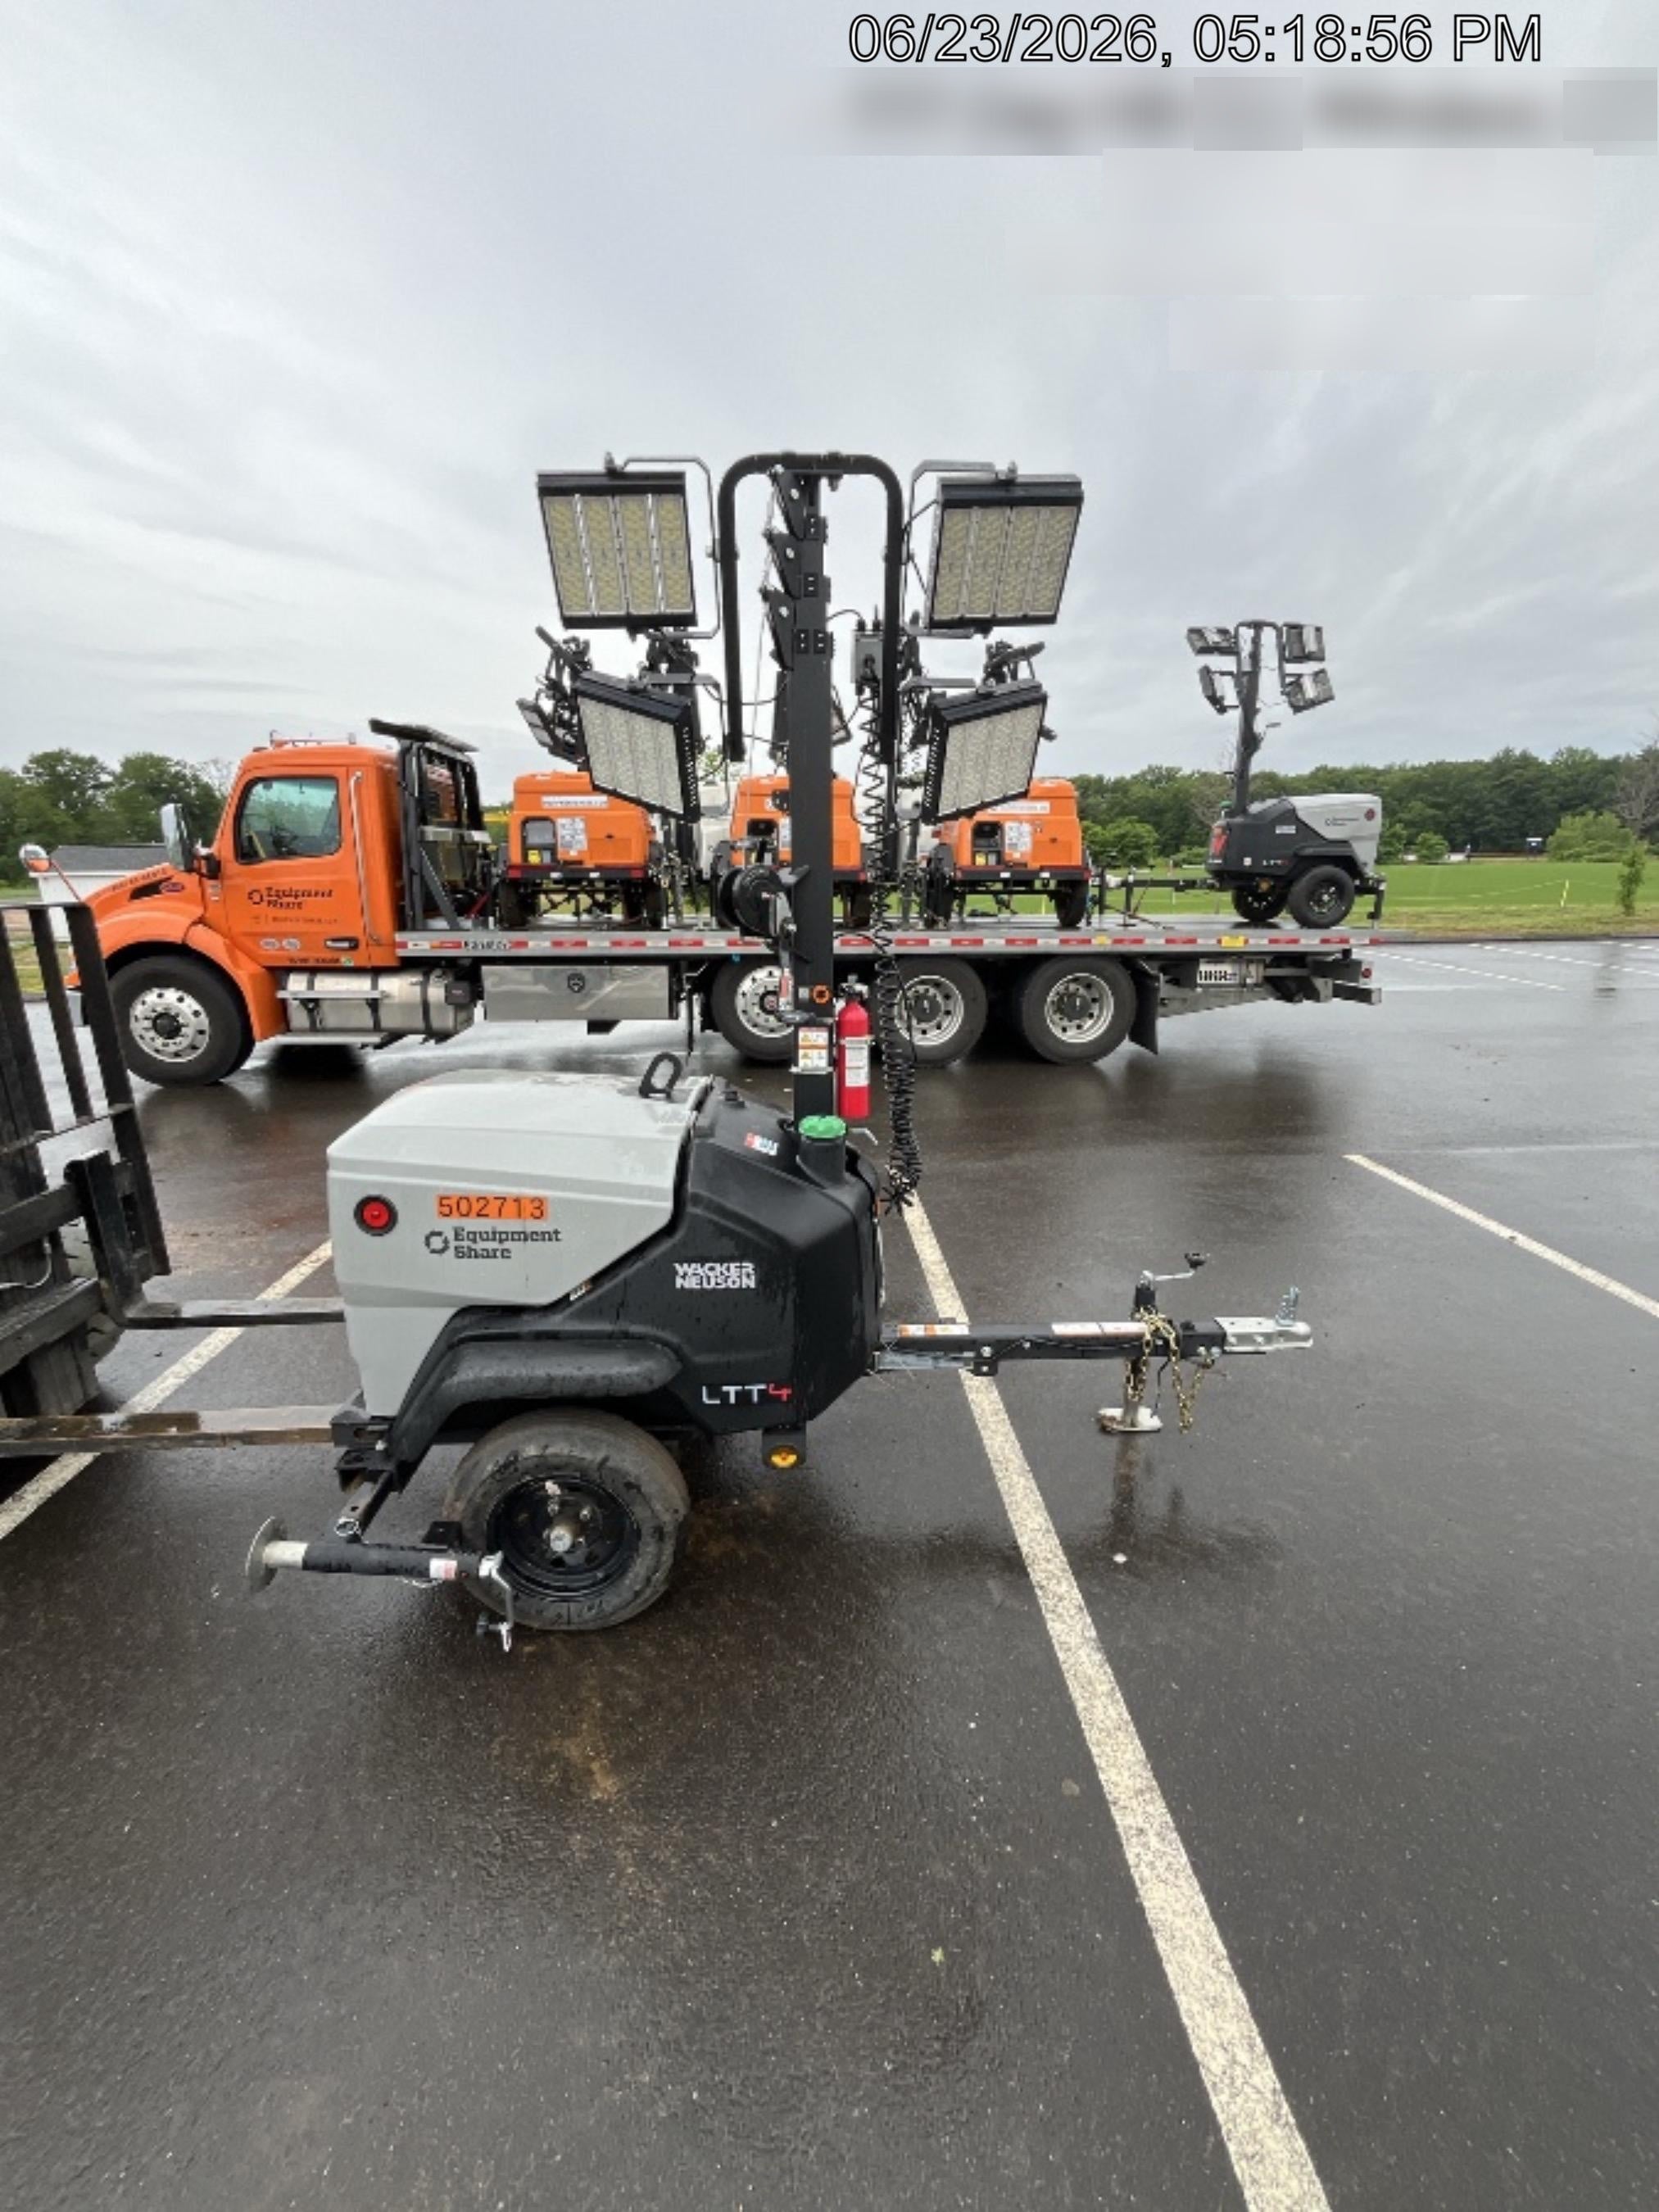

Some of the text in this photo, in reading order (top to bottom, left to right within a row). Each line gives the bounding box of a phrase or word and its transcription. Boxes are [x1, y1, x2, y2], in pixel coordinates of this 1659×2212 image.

[437, 1195, 545, 1220] 502713
[452, 1226, 562, 1245] Equipment
[453, 1244, 512, 1259] Share
[673, 1262, 755, 1277] WACKER
[674, 1274, 756, 1290] NEUSON
[701, 1382, 793, 1405] LTT4
